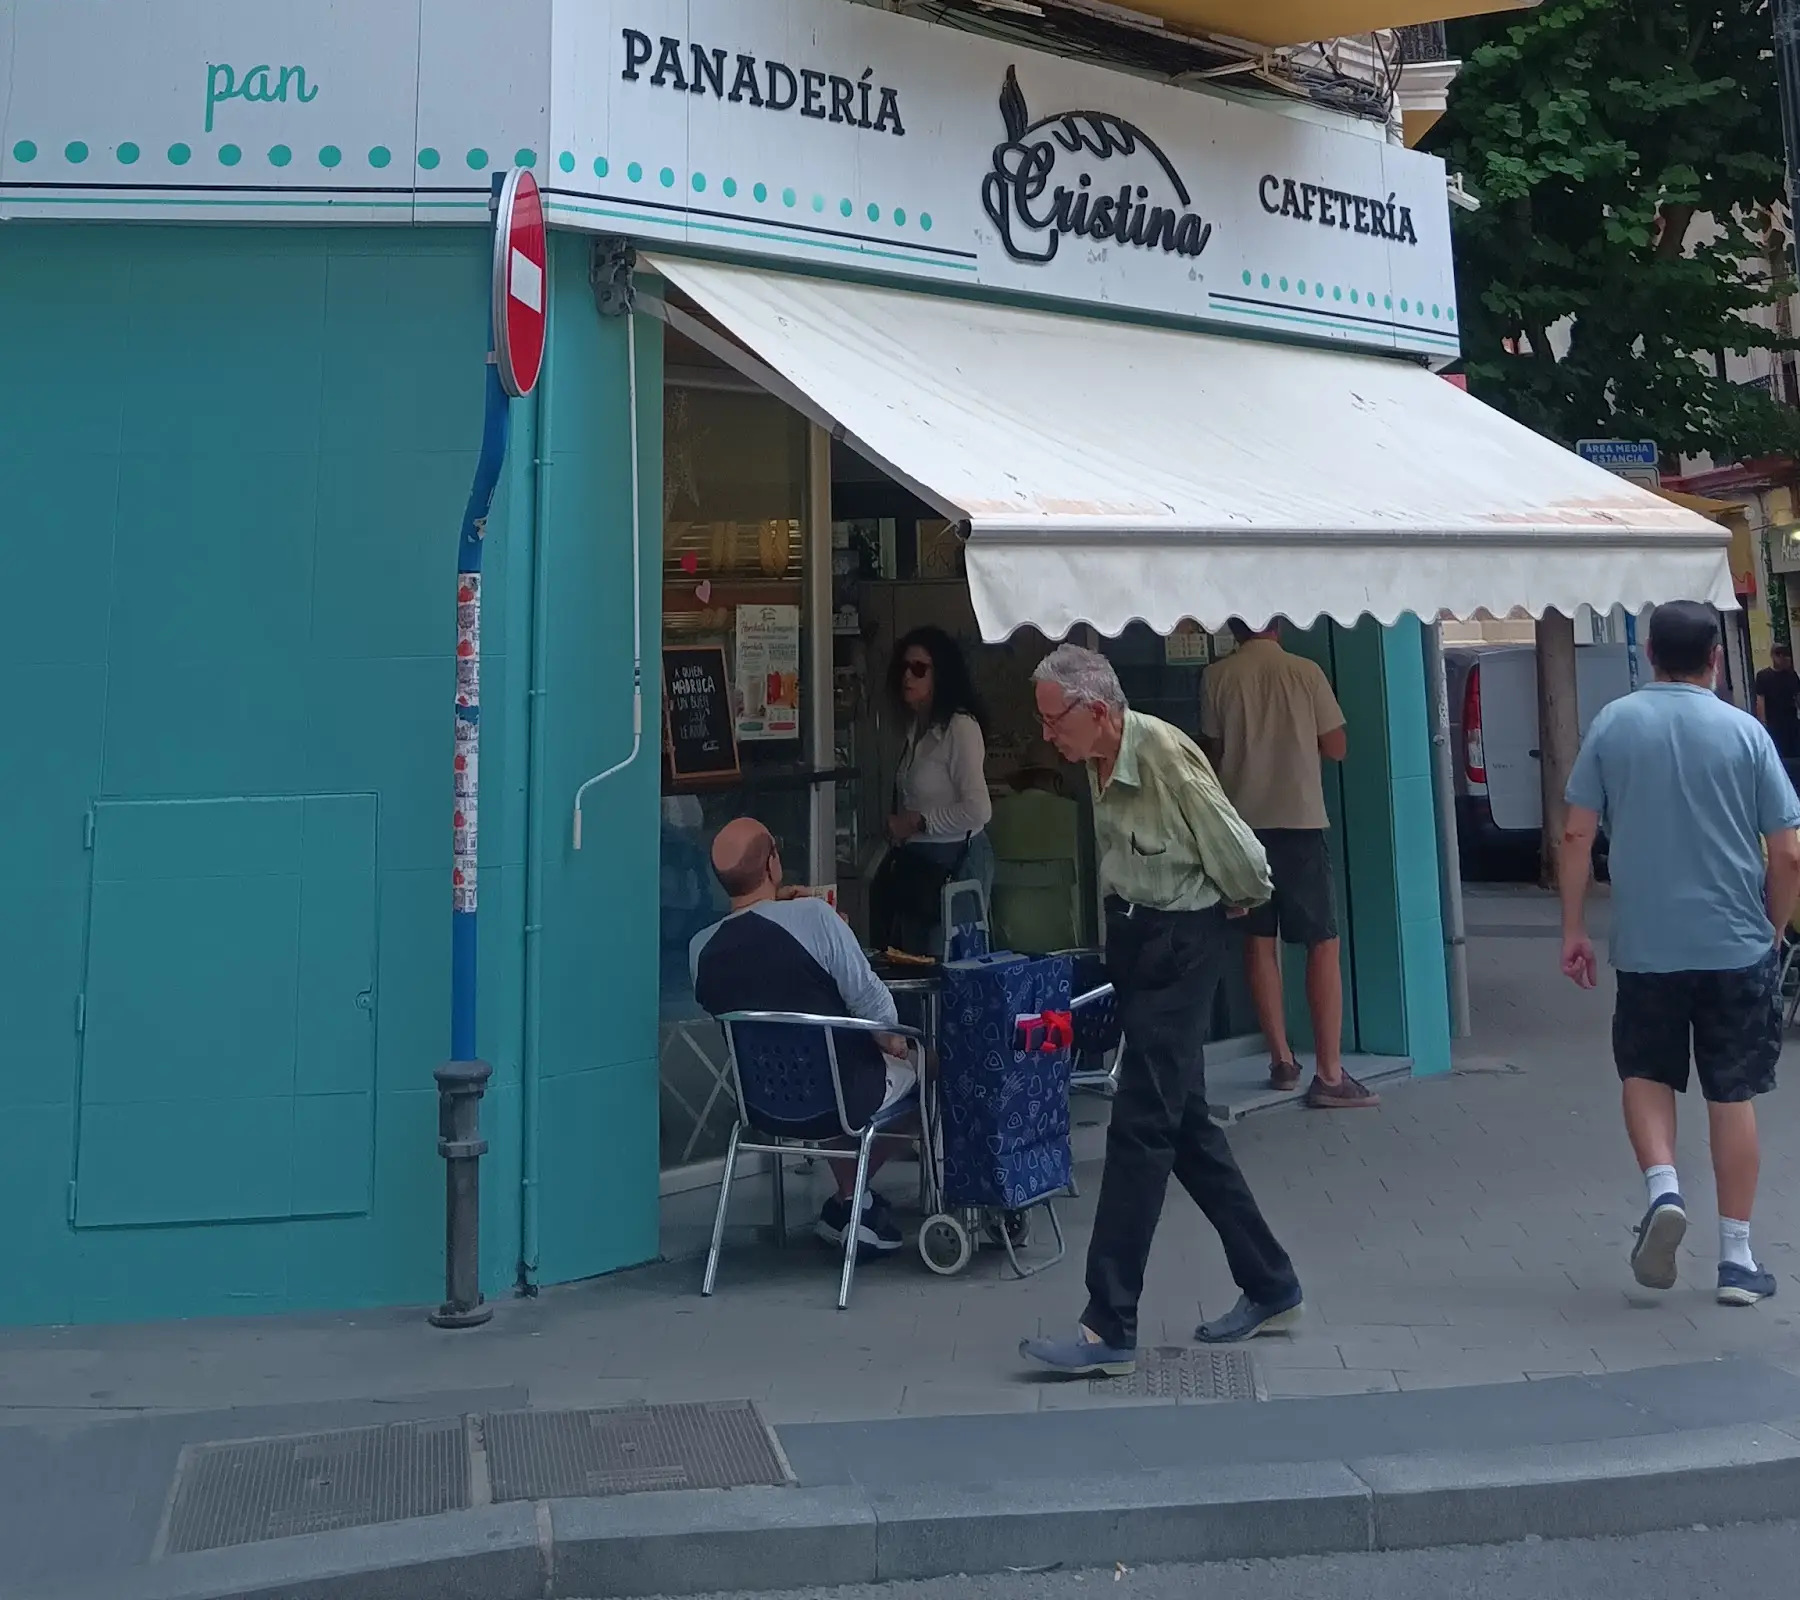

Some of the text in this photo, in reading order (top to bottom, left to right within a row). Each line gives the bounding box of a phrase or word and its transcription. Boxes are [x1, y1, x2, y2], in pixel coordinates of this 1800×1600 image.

[203, 61, 319, 133] pan
[621, 27, 907, 137] PANADERÍA
[1014, 141, 1212, 257] Cristina
[1258, 174, 1418, 245] CAFETERÍA
[1585, 442, 1649, 453] ÁREA MEDIA
[1592, 454, 1644, 463] ESTANCIA
[681, 665, 704, 678] QUIEN
[676, 696, 689, 711] UN
